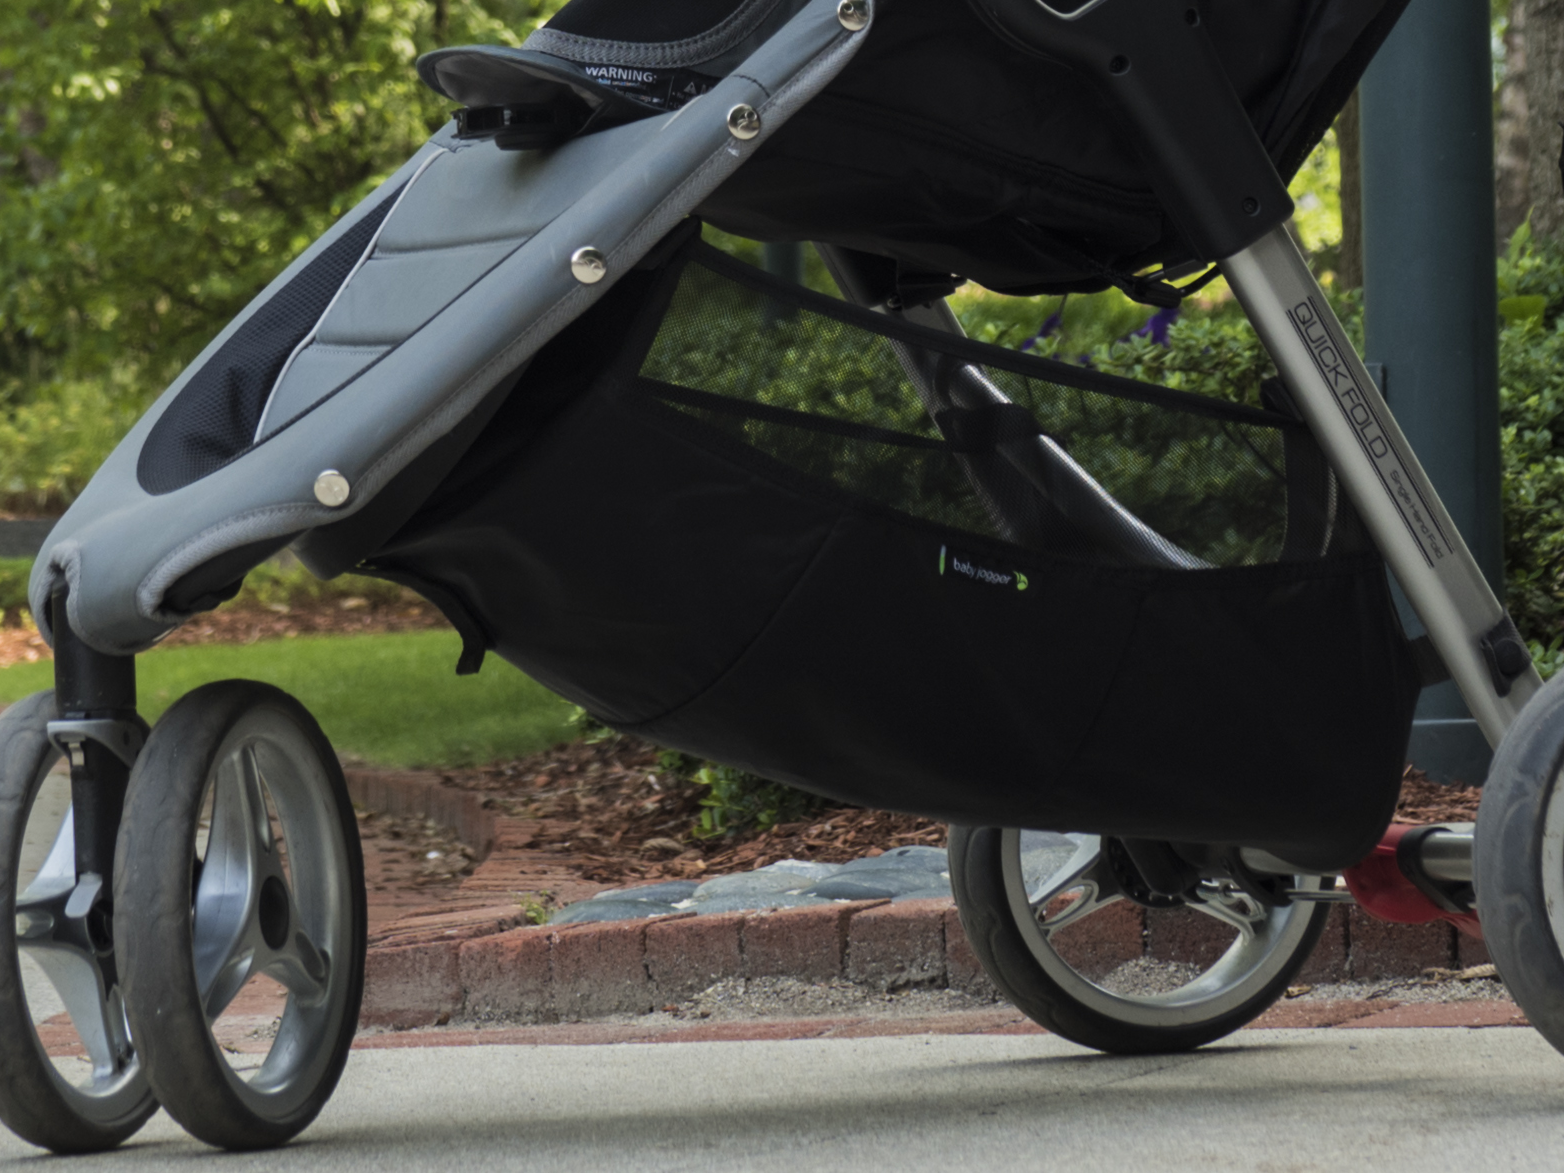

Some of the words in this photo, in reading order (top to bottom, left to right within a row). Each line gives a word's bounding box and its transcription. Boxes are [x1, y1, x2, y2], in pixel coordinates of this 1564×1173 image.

[585, 66, 657, 83] WARNING:
[1293, 301, 1349, 388] QUICK
[1341, 387, 1389, 459] FOLD
[1390, 469, 1412, 505] Single
[953, 557, 976, 578] baby
[976, 567, 1012, 584] jogger
